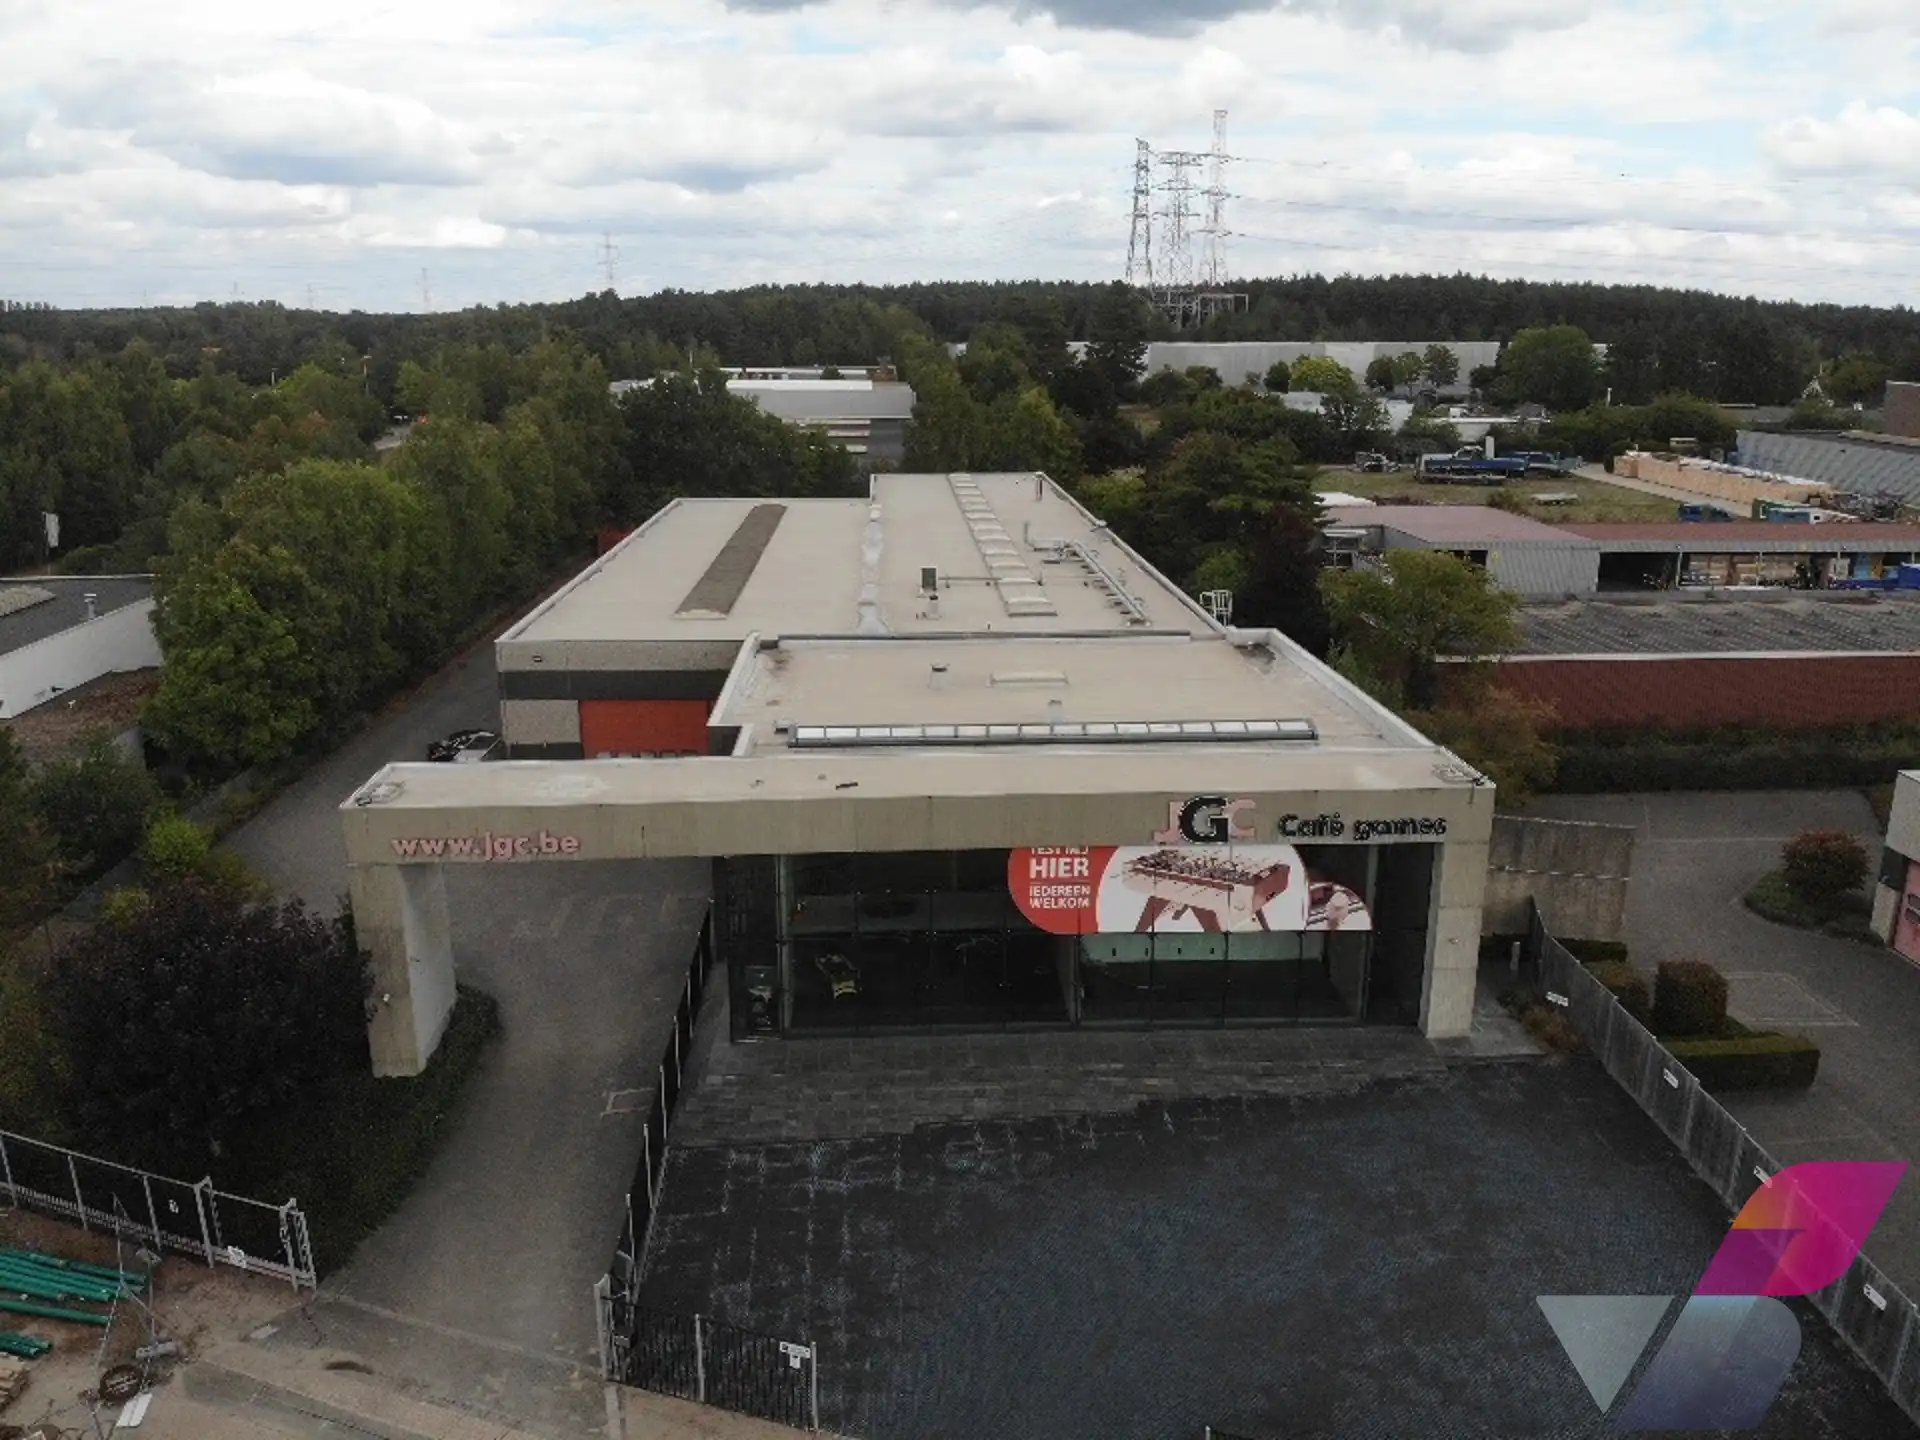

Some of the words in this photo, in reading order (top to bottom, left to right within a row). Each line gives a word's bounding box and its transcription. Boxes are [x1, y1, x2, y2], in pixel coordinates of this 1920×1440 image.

[1153, 794, 1257, 844] JGC
[1353, 817, 1448, 841] games
[391, 829, 581, 861] www.jgc.be
[1029, 857, 1089, 878] HIER
[1029, 885, 1091, 896] IEDEREEN
[1029, 897, 1090, 909] WELKOM
